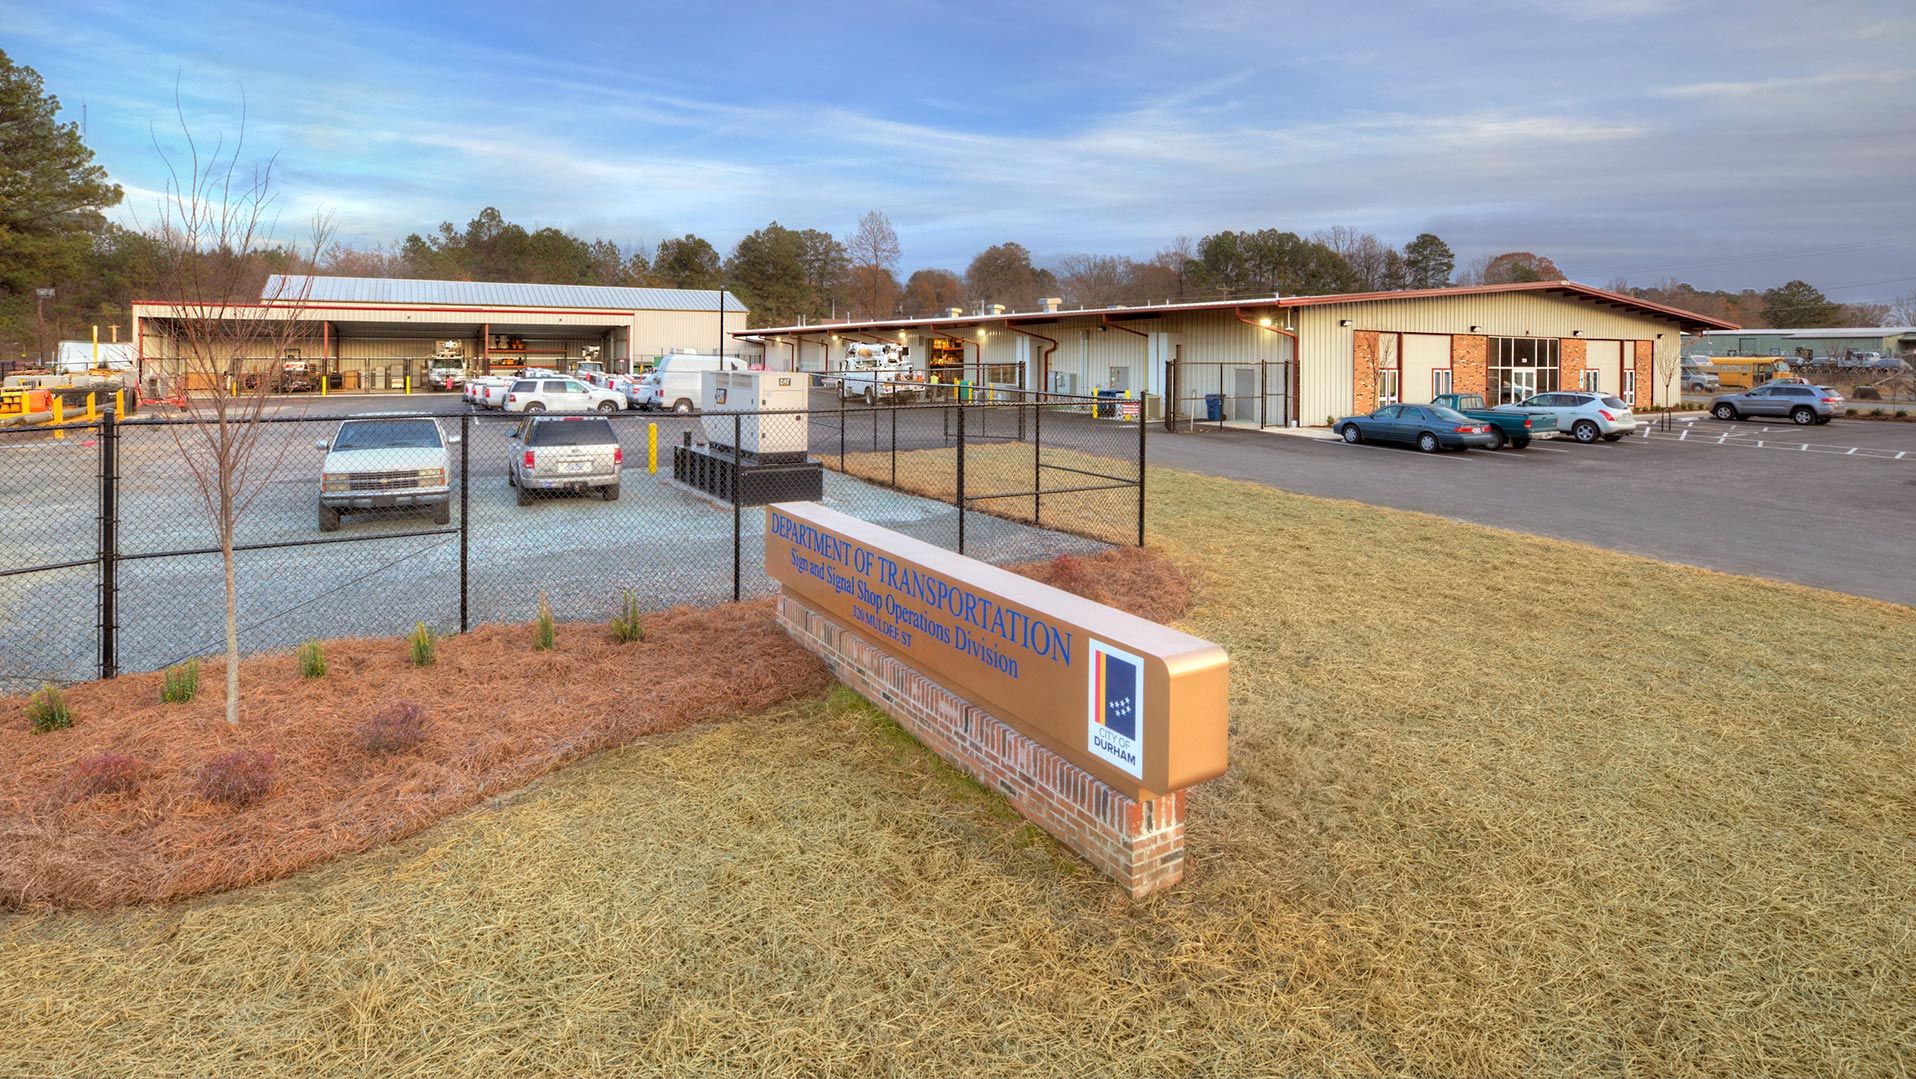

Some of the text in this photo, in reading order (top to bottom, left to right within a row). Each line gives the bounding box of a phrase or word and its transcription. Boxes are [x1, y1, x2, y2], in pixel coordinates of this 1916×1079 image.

[772, 512, 1072, 667] DEPARTMENT OF TRANSPORTATION
[791, 547, 1019, 679] Sign and Signal Shop Operations Division
[866, 612, 900, 642] MULDEE
[902, 631, 912, 648] ST
[1094, 735, 1136, 766] DURHAM
[1099, 728, 1131, 749] CITY OF
